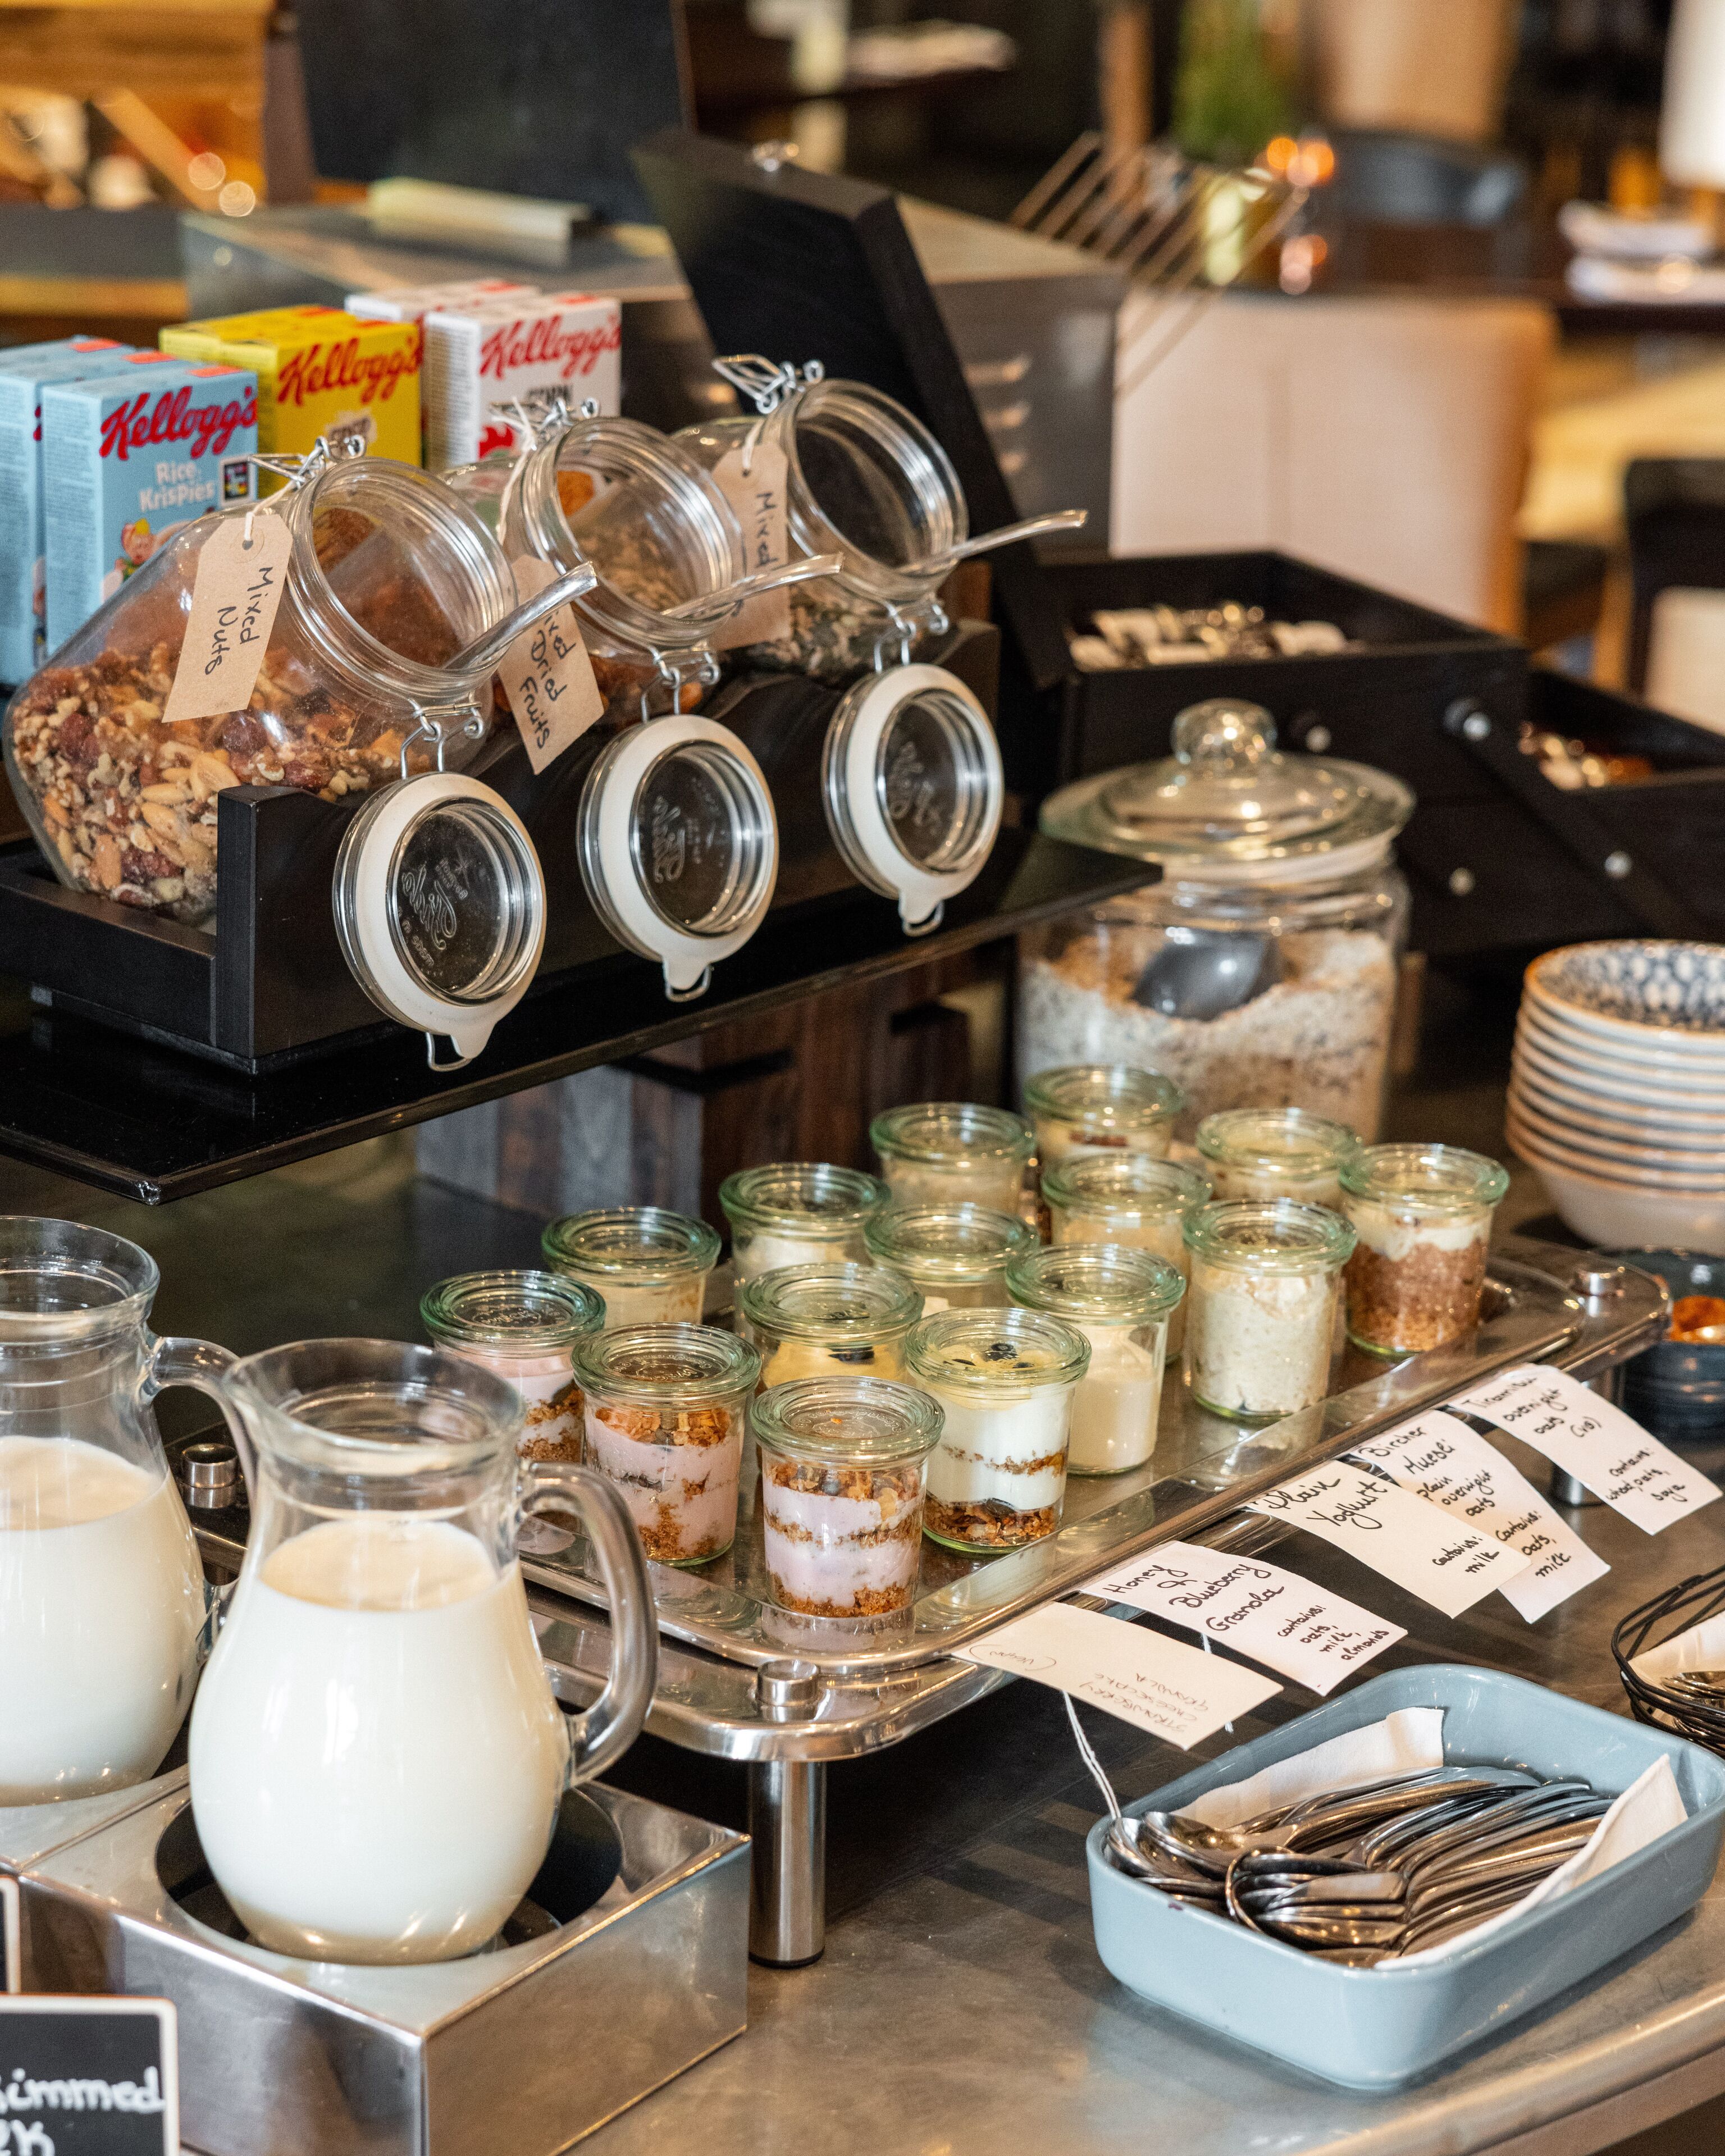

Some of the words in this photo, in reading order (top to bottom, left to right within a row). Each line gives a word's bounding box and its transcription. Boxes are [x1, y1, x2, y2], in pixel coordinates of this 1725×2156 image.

[480, 314, 620, 380] Kellogg's
[277, 336, 423, 408] Kellogg's
[100, 386, 258, 460] Kellogg's
[155, 462, 197, 484] Rice
[240, 567, 274, 645] Mixed
[205, 606, 239, 675] Nuts
[531, 630, 568, 701] Dried
[520, 677, 550, 749] Fruits
[1358, 1427, 1426, 1457] Bircher
[1534, 1416, 1564, 1434] oats
[1403, 1438, 1455, 1474] Muesli
[1306, 1481, 1388, 1529] Yoghurt
[1465, 1497, 1495, 1516] oats
[1102, 1564, 1188, 1593] Honey
[1464, 1551, 1500, 1573] milk
[1206, 1586, 1284, 1631] Granola
[1341, 1629, 1390, 1660] almonds
[0, 2066, 165, 2114] immed
